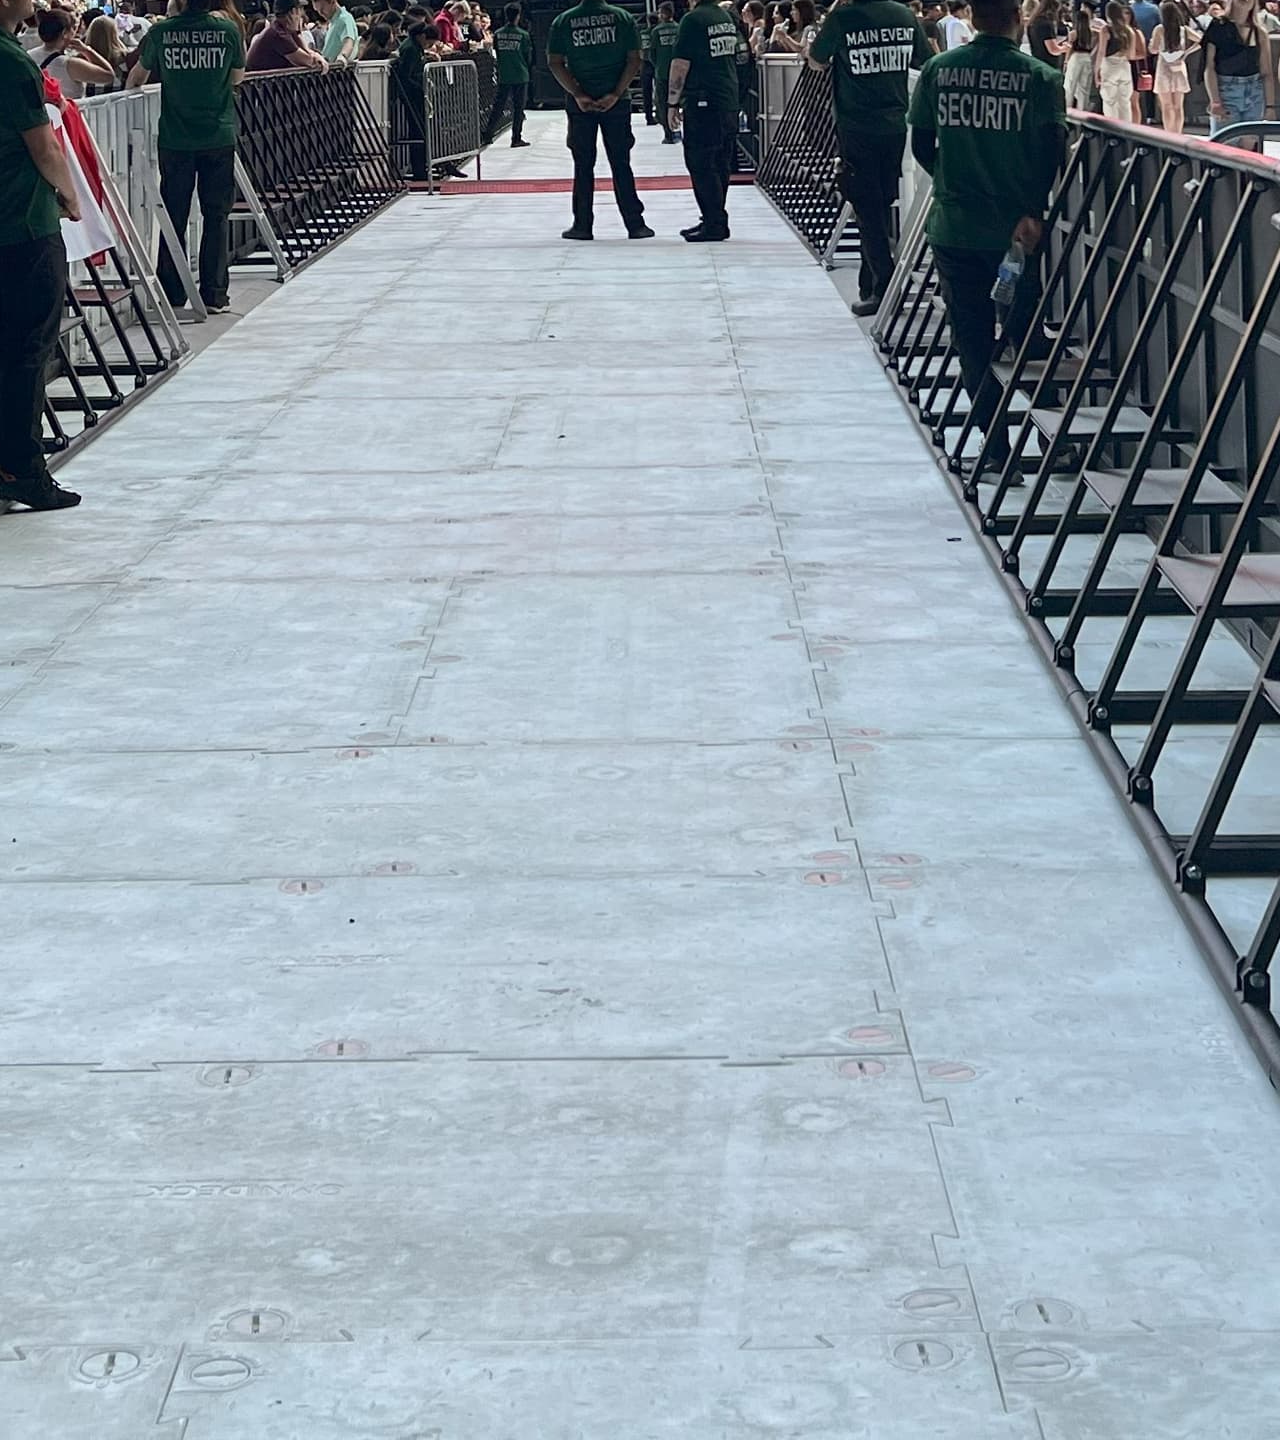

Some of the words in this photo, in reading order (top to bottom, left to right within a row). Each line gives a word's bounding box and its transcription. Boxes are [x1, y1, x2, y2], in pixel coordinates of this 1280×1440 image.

[570, 16, 590, 28] MAIN
[590, 13, 615, 26] EVENT
[162, 31, 189, 44] MAIN
[191, 30, 226, 44] EVENT
[571, 25, 617, 47] SECURITY
[846, 29, 879, 47] MAIN
[880, 27, 914, 43] EVENT
[164, 47, 226, 69] SECURITY
[937, 66, 976, 88] MAIN
[978, 69, 1031, 92] EVENT
[937, 92, 1028, 132] SECURITY
